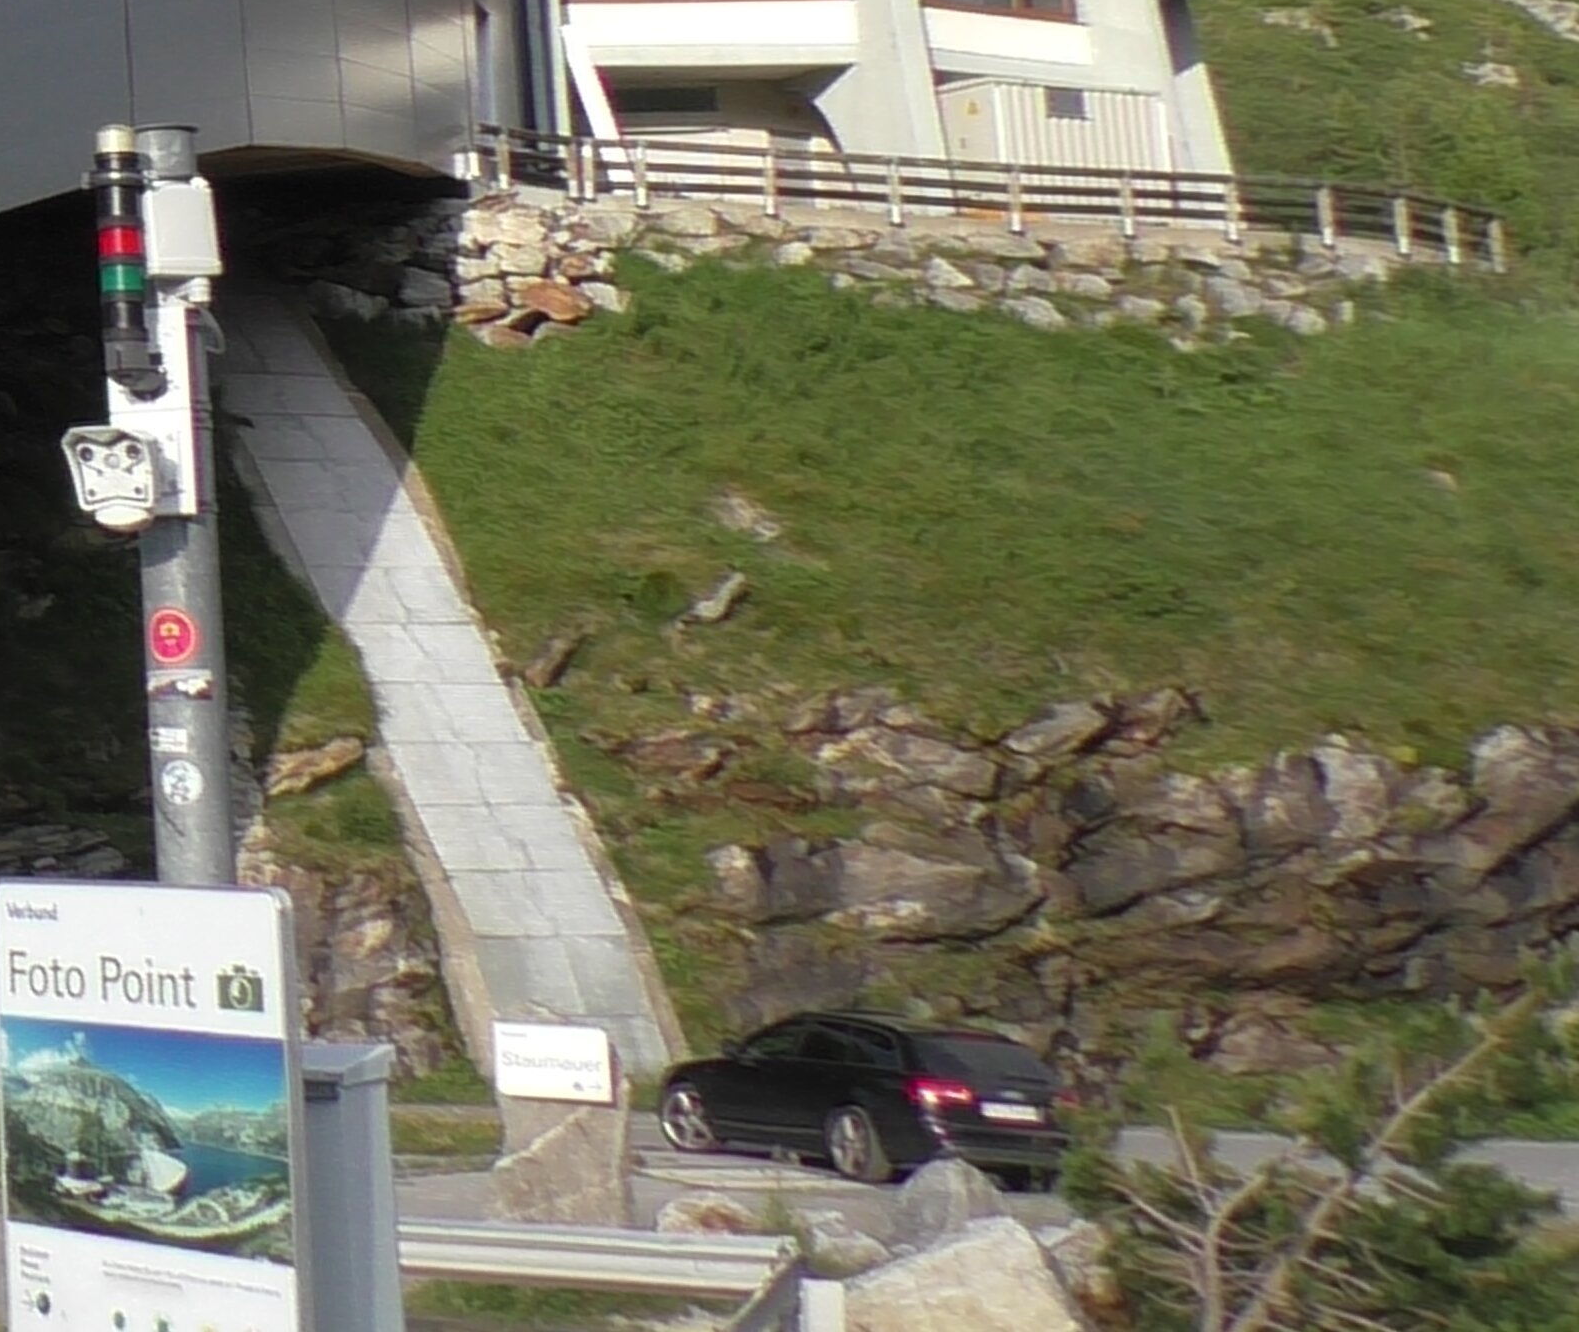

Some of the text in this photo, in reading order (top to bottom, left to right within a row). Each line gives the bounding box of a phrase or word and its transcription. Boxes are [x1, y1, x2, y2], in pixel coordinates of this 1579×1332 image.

[5, 902, 59, 921] Verbund
[8, 949, 197, 1008] Foto Point
[500, 1050, 603, 1073] Staumauer
